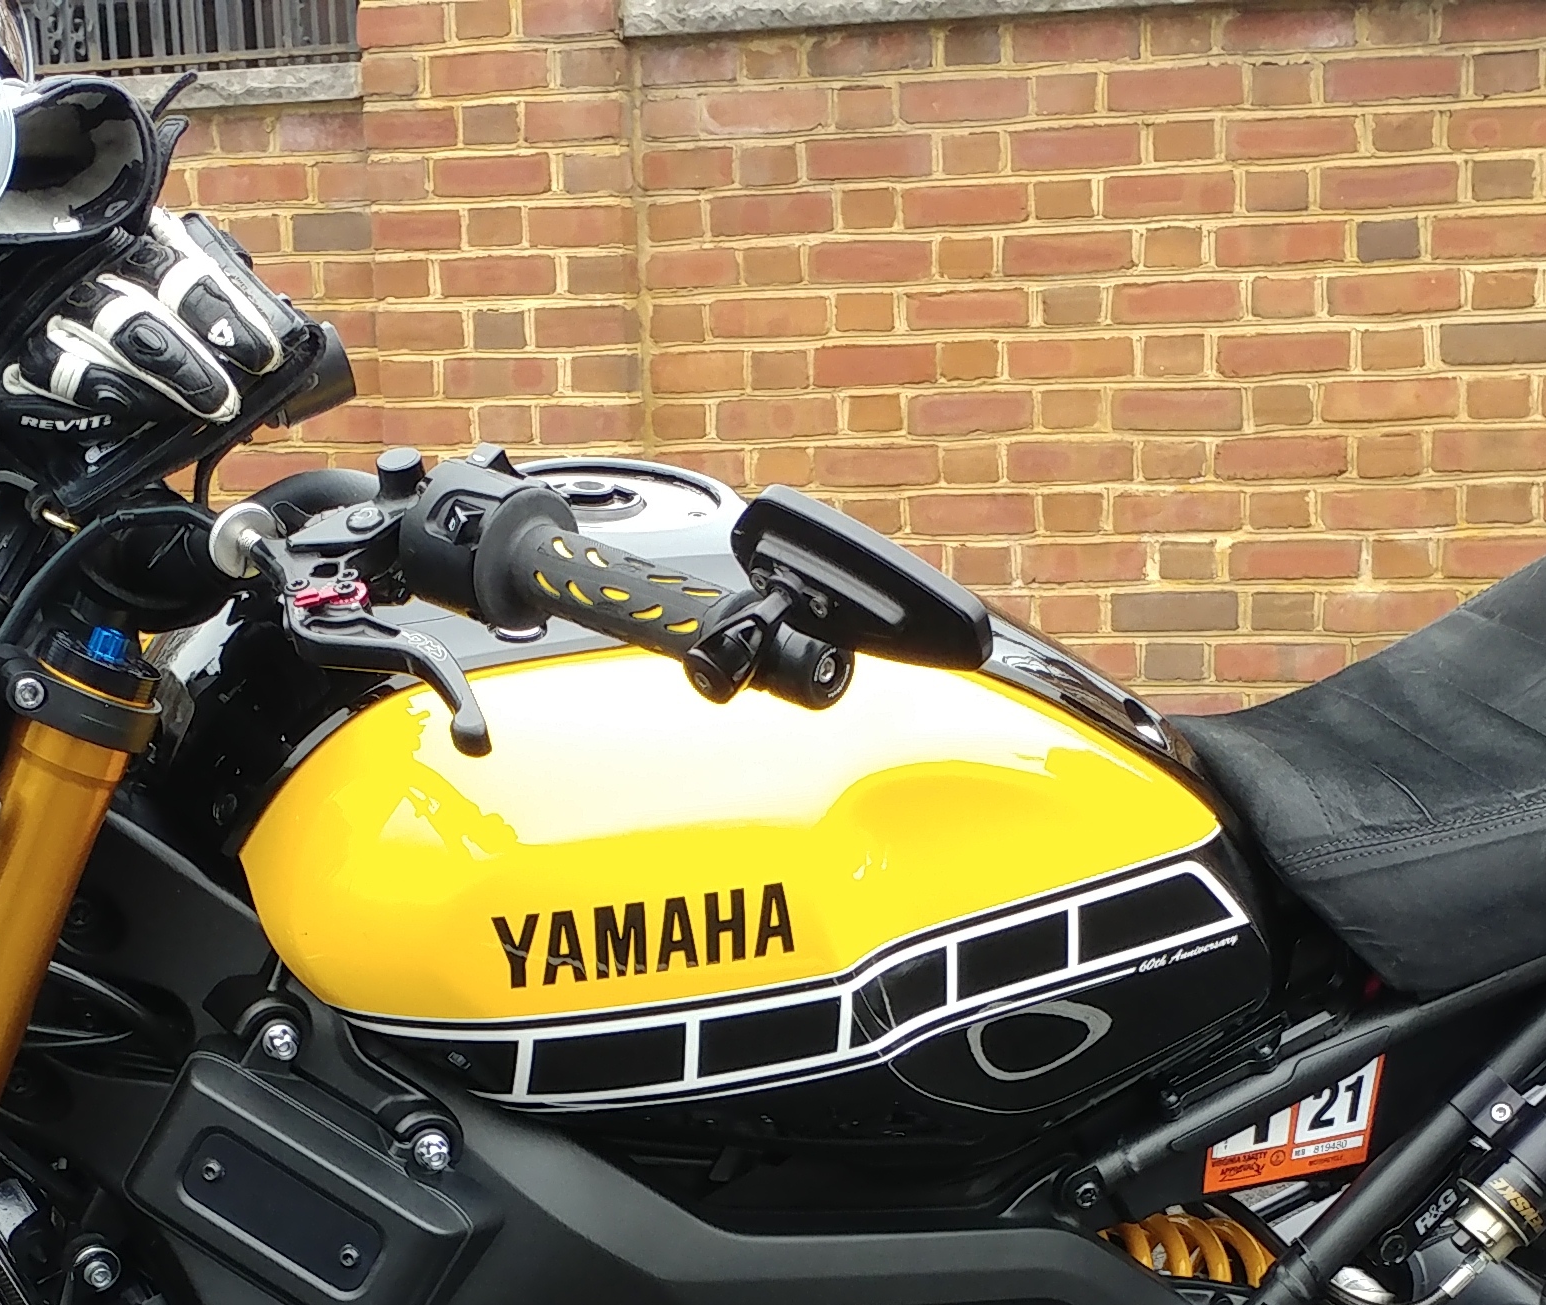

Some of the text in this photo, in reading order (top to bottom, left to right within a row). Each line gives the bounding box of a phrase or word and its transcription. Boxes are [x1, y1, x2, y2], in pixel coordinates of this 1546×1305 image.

[491, 882, 795, 989] YAMAHA
[1138, 934, 1239, 973] 60th Anniversary
[1307, 1075, 1365, 1131] 21
[1415, 1188, 1458, 1236] R&G
